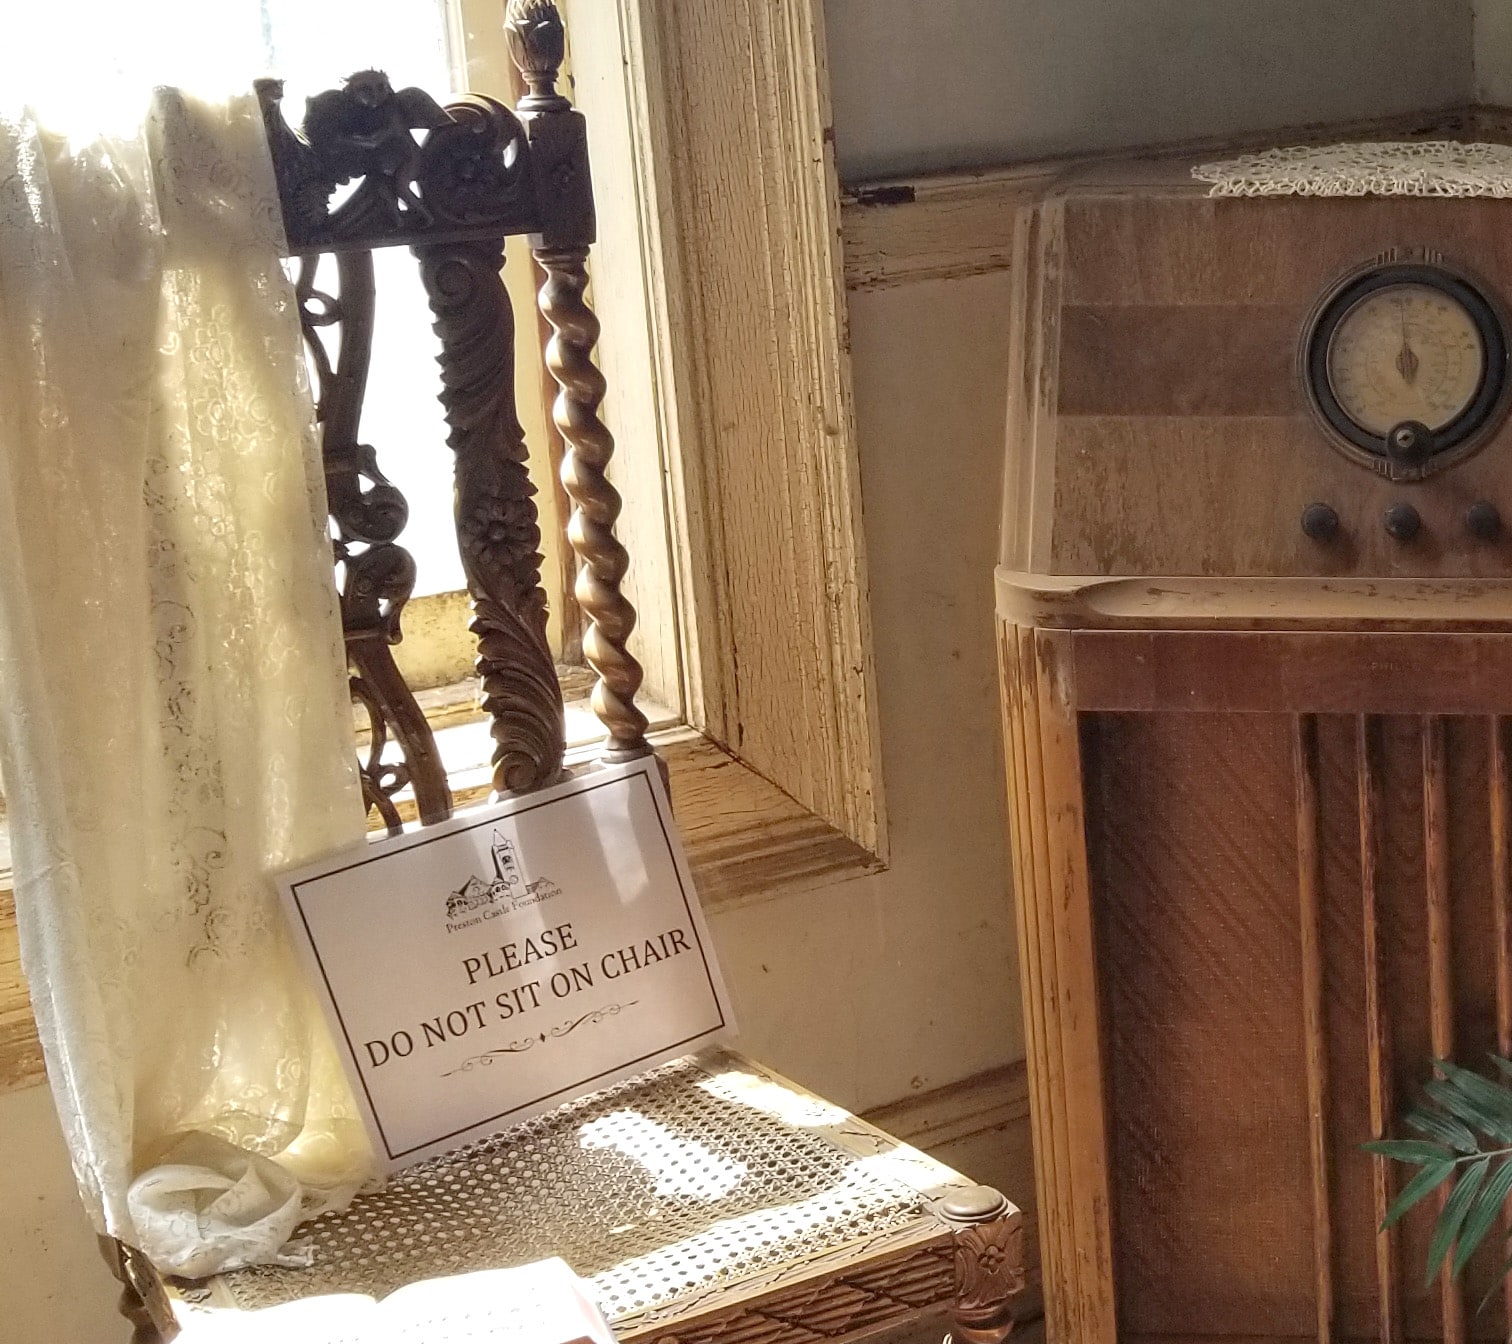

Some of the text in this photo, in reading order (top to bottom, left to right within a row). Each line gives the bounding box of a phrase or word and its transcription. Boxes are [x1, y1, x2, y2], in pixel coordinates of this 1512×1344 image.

[446, 916, 482, 933] Preston
[511, 887, 562, 910] Foundation
[462, 923, 577, 984] PLEASE
[364, 929, 692, 1068] DO NOT SIT ON CHAIR
